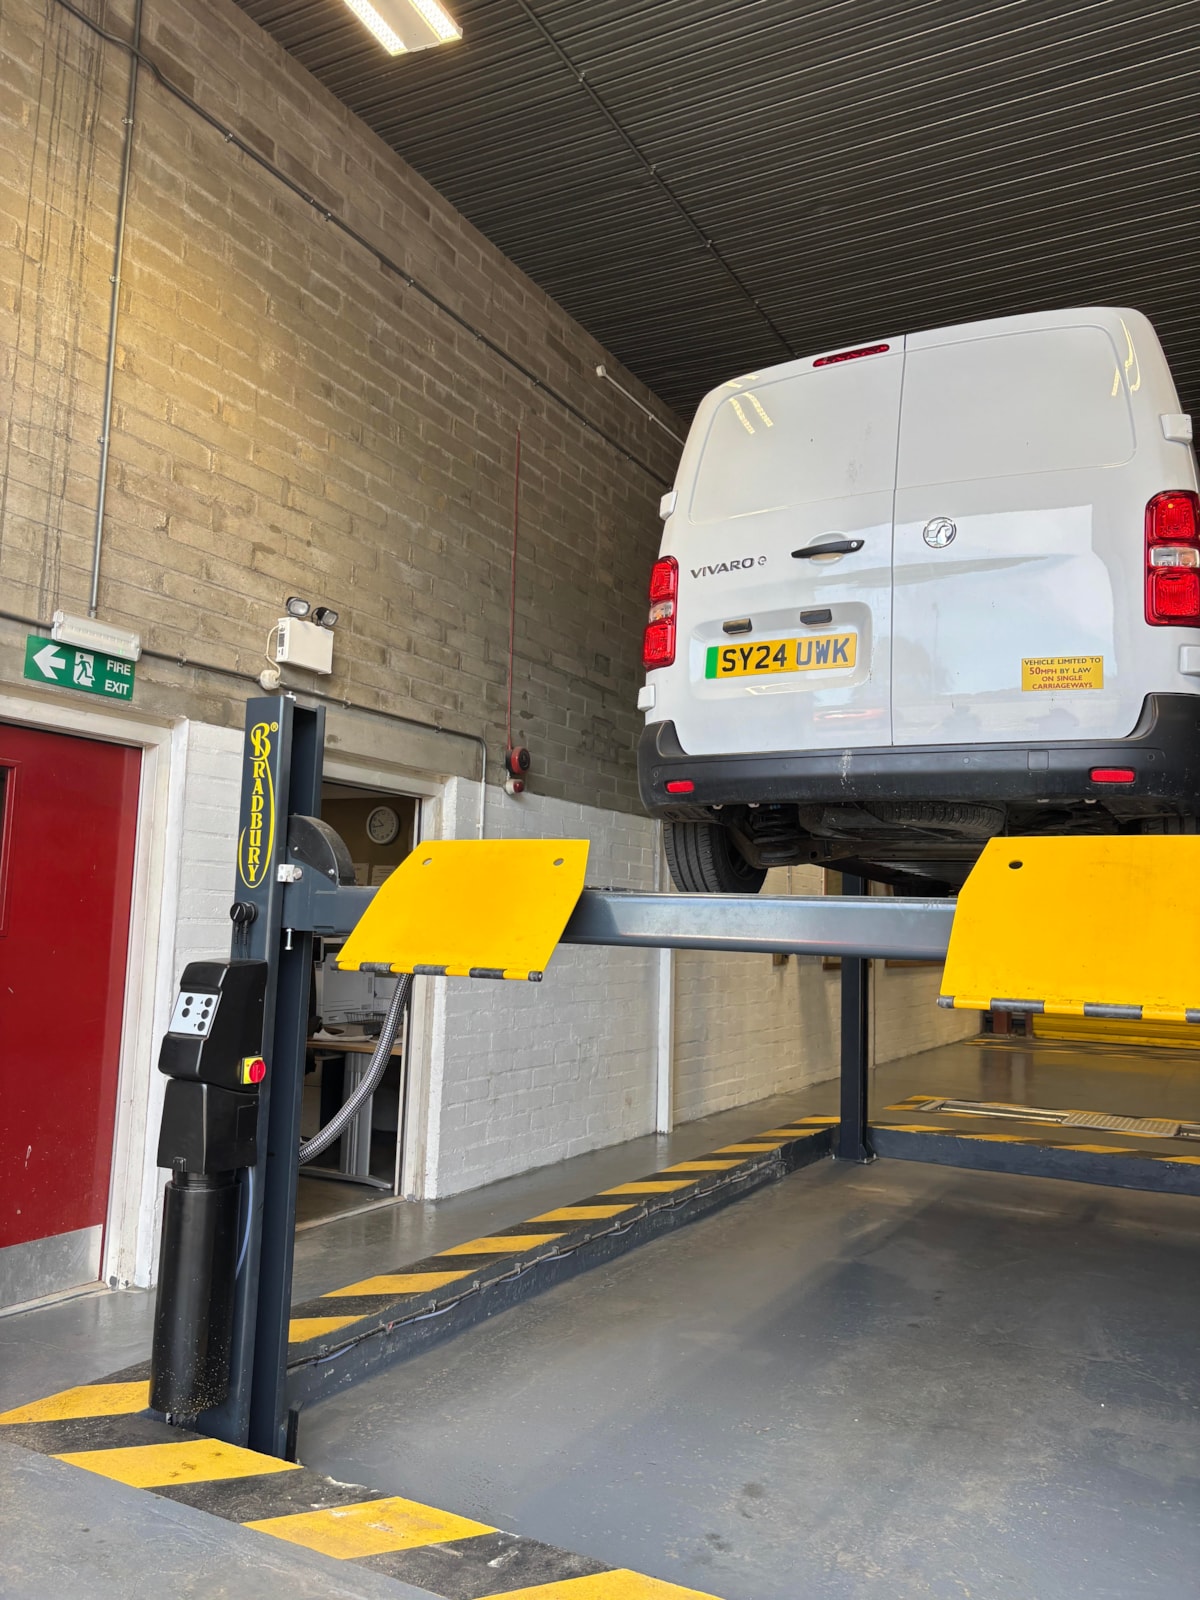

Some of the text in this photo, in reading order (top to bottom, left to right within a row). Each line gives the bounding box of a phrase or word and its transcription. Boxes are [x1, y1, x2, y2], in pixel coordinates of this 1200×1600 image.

[690, 557, 755, 578] VIVARO
[722, 637, 850, 673] SY24 UWK
[106, 659, 132, 676] FIRE
[1029, 666, 1057, 675] 50MPH
[1056, 674, 1083, 682] SINGLE
[104, 679, 130, 696] EXIT
[245, 722, 275, 883] BRADBURY
